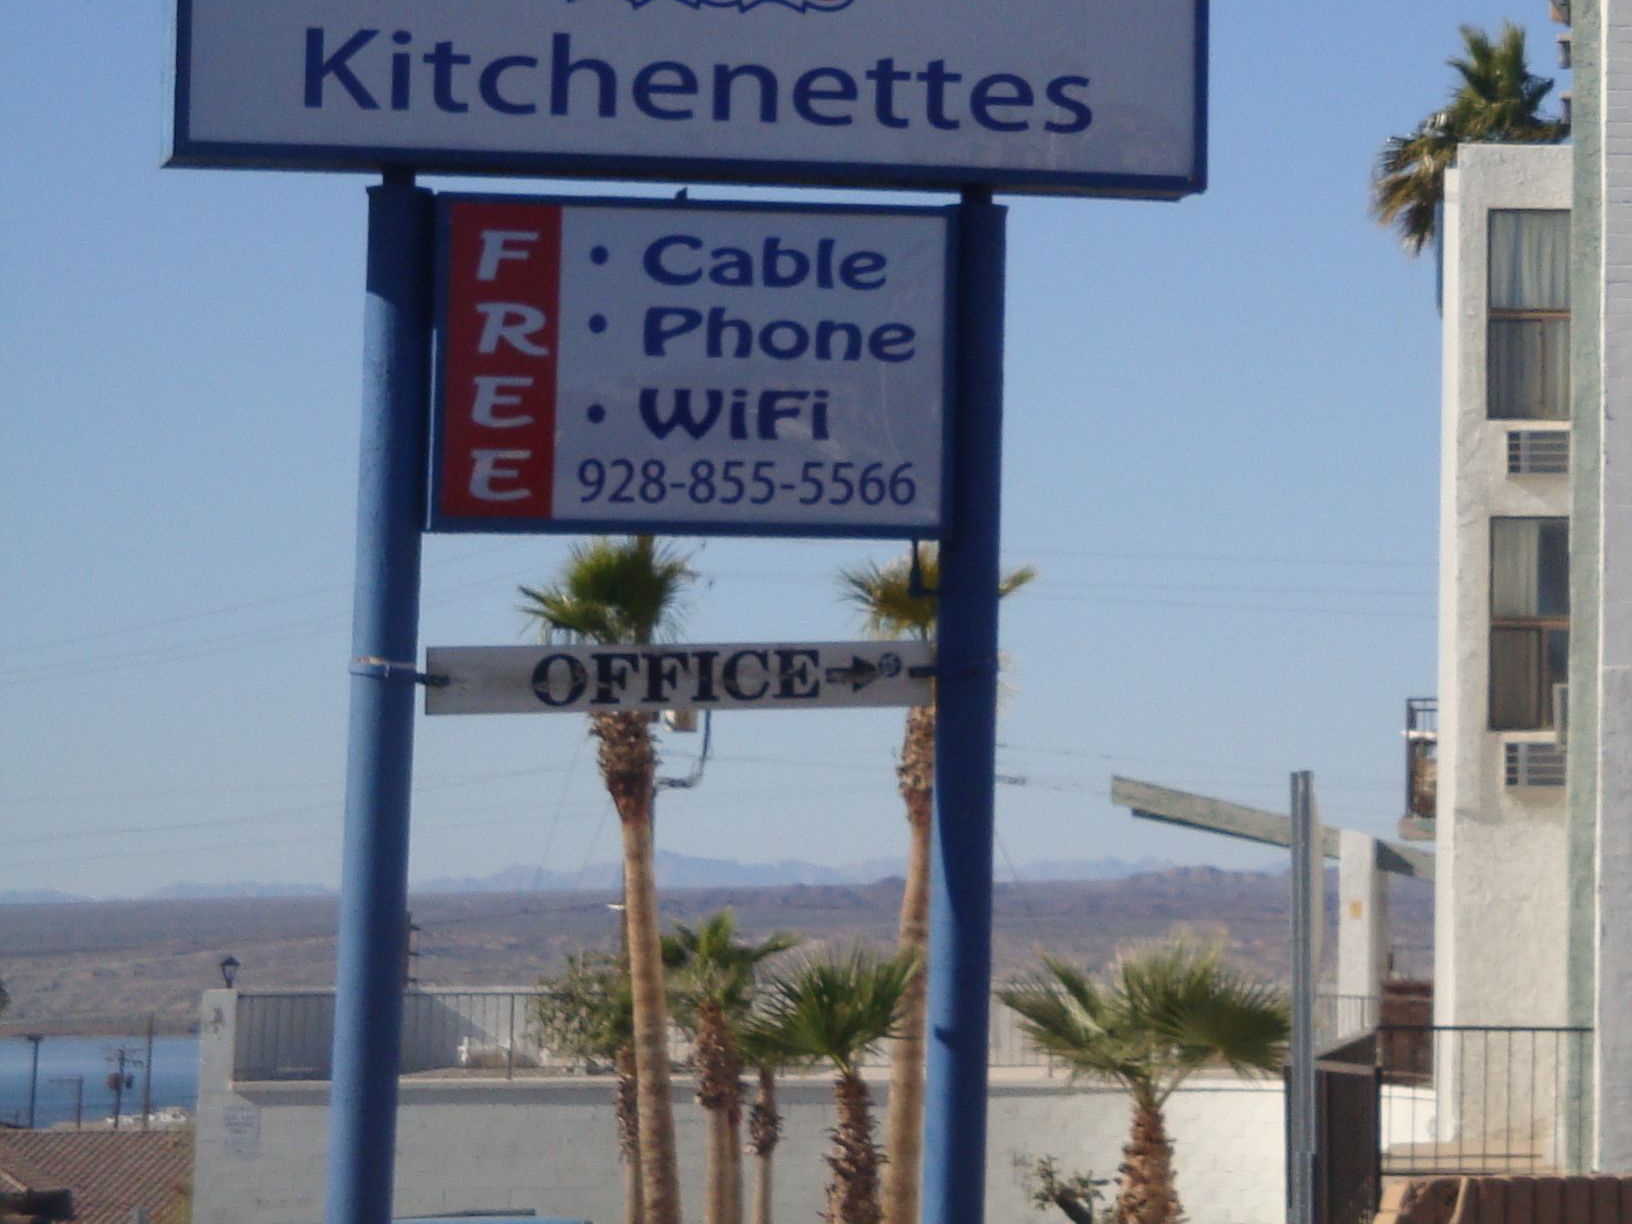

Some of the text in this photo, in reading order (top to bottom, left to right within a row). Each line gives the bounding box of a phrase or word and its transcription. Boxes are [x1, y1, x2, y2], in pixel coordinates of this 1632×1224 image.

[303, 27, 1094, 135] Kitchenettes
[642, 234, 888, 290] Cable
[642, 306, 916, 362] Phone
[467, 229, 550, 502] FREE
[639, 388, 831, 441] WiFi
[577, 458, 917, 506] 928-855-5566
[530, 648, 821, 708] OFFICE
